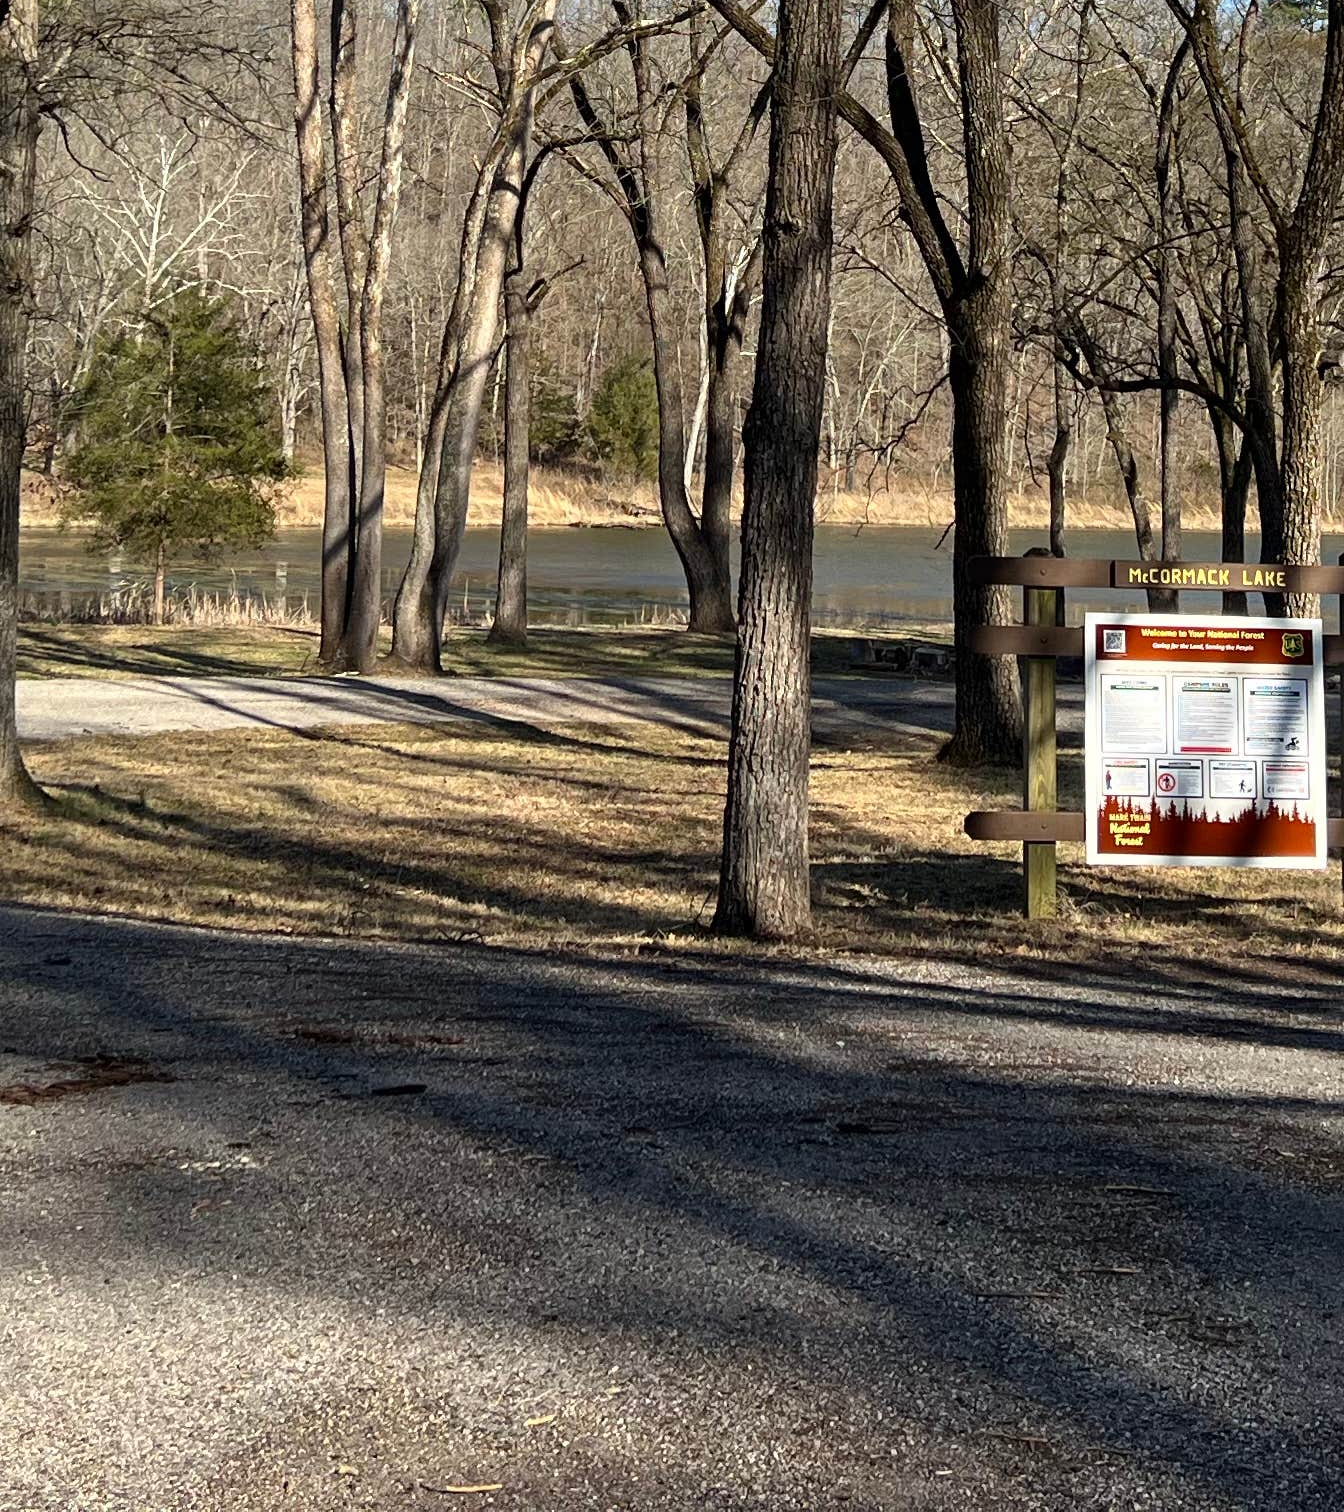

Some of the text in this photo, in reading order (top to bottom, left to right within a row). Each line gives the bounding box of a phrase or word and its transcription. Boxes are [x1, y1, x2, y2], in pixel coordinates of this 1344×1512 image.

[1129, 567, 1287, 587] McCORMACK LAKE
[1141, 628, 1265, 640] Welcome to Your National Forest
[1109, 822, 1150, 834] National
[1114, 834, 1143, 846] Forest
